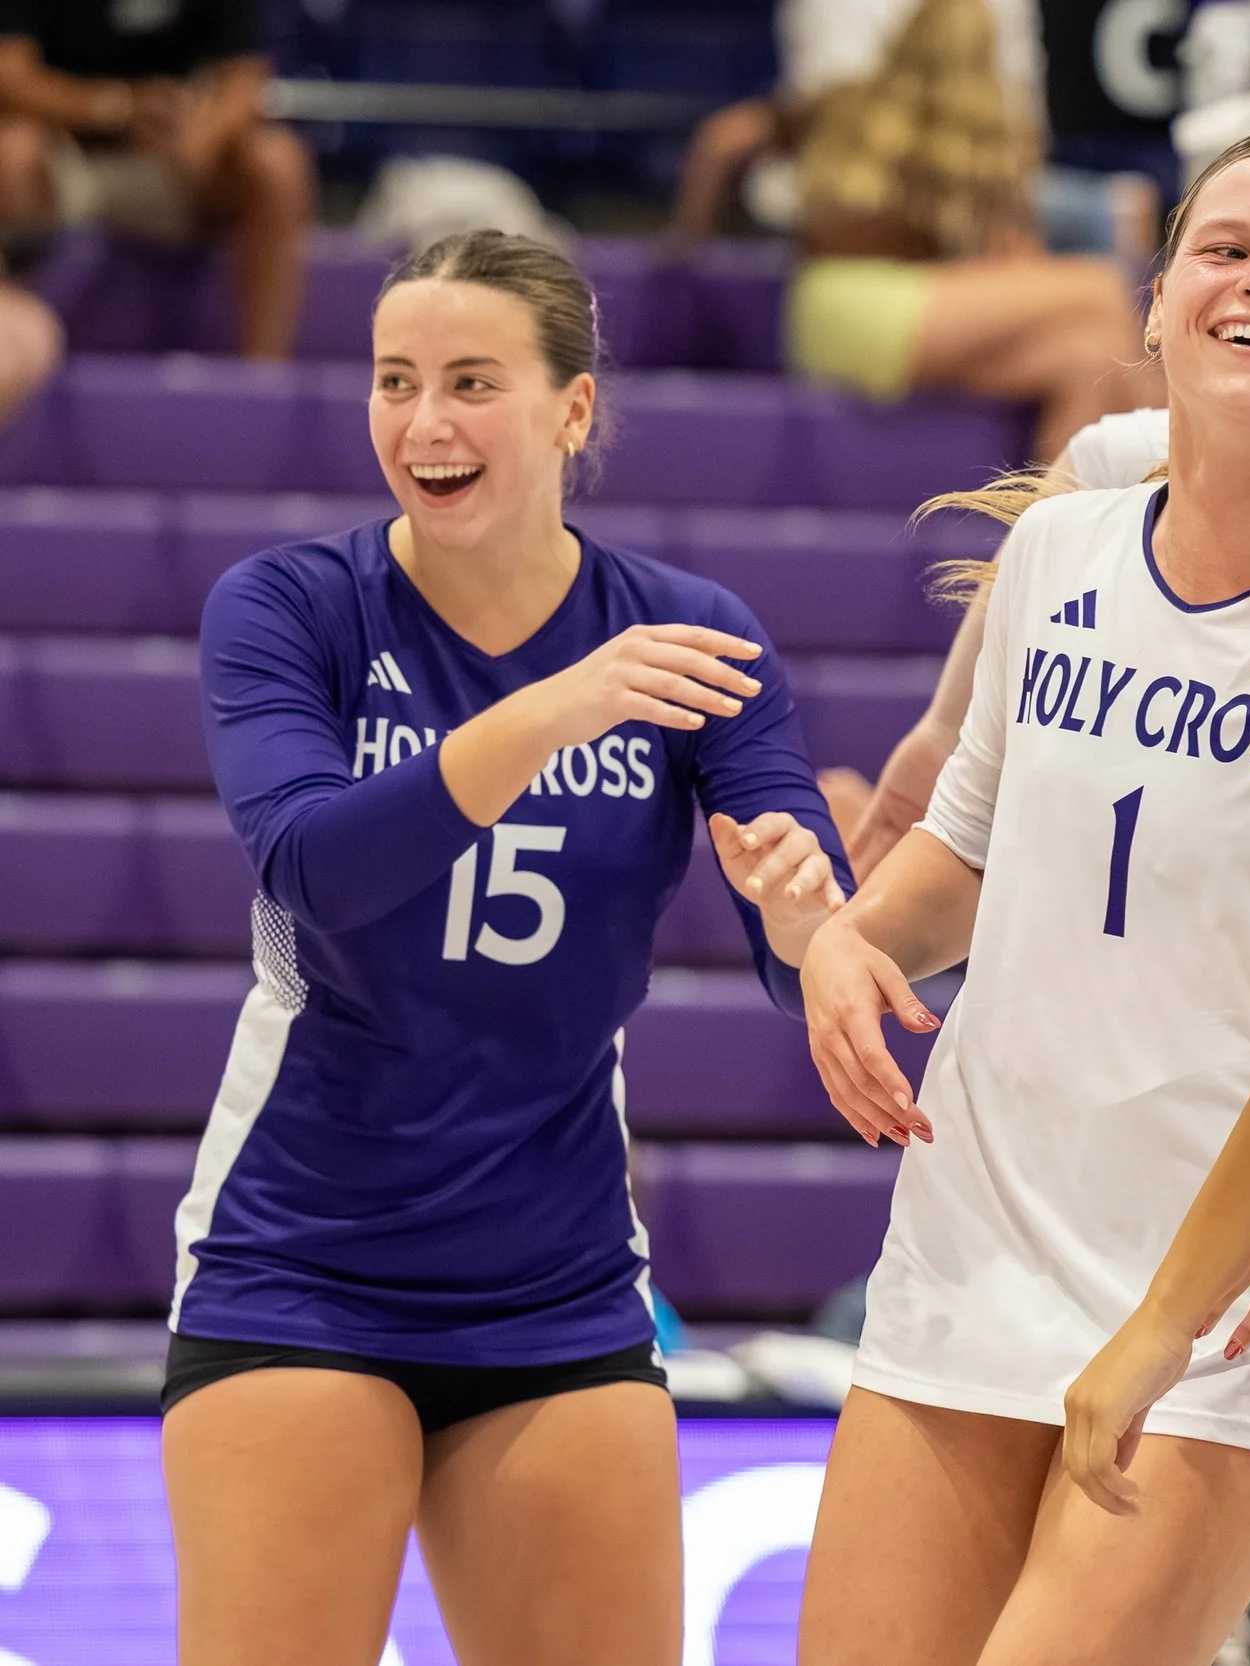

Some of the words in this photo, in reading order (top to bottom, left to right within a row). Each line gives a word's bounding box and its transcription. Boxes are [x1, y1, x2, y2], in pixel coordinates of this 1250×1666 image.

[1016, 647, 1137, 737] HOLY
[353, 717, 453, 779] HO
[529, 735, 656, 800] ROSS
[442, 823, 567, 966] 15
[1103, 785, 1145, 938] 1
